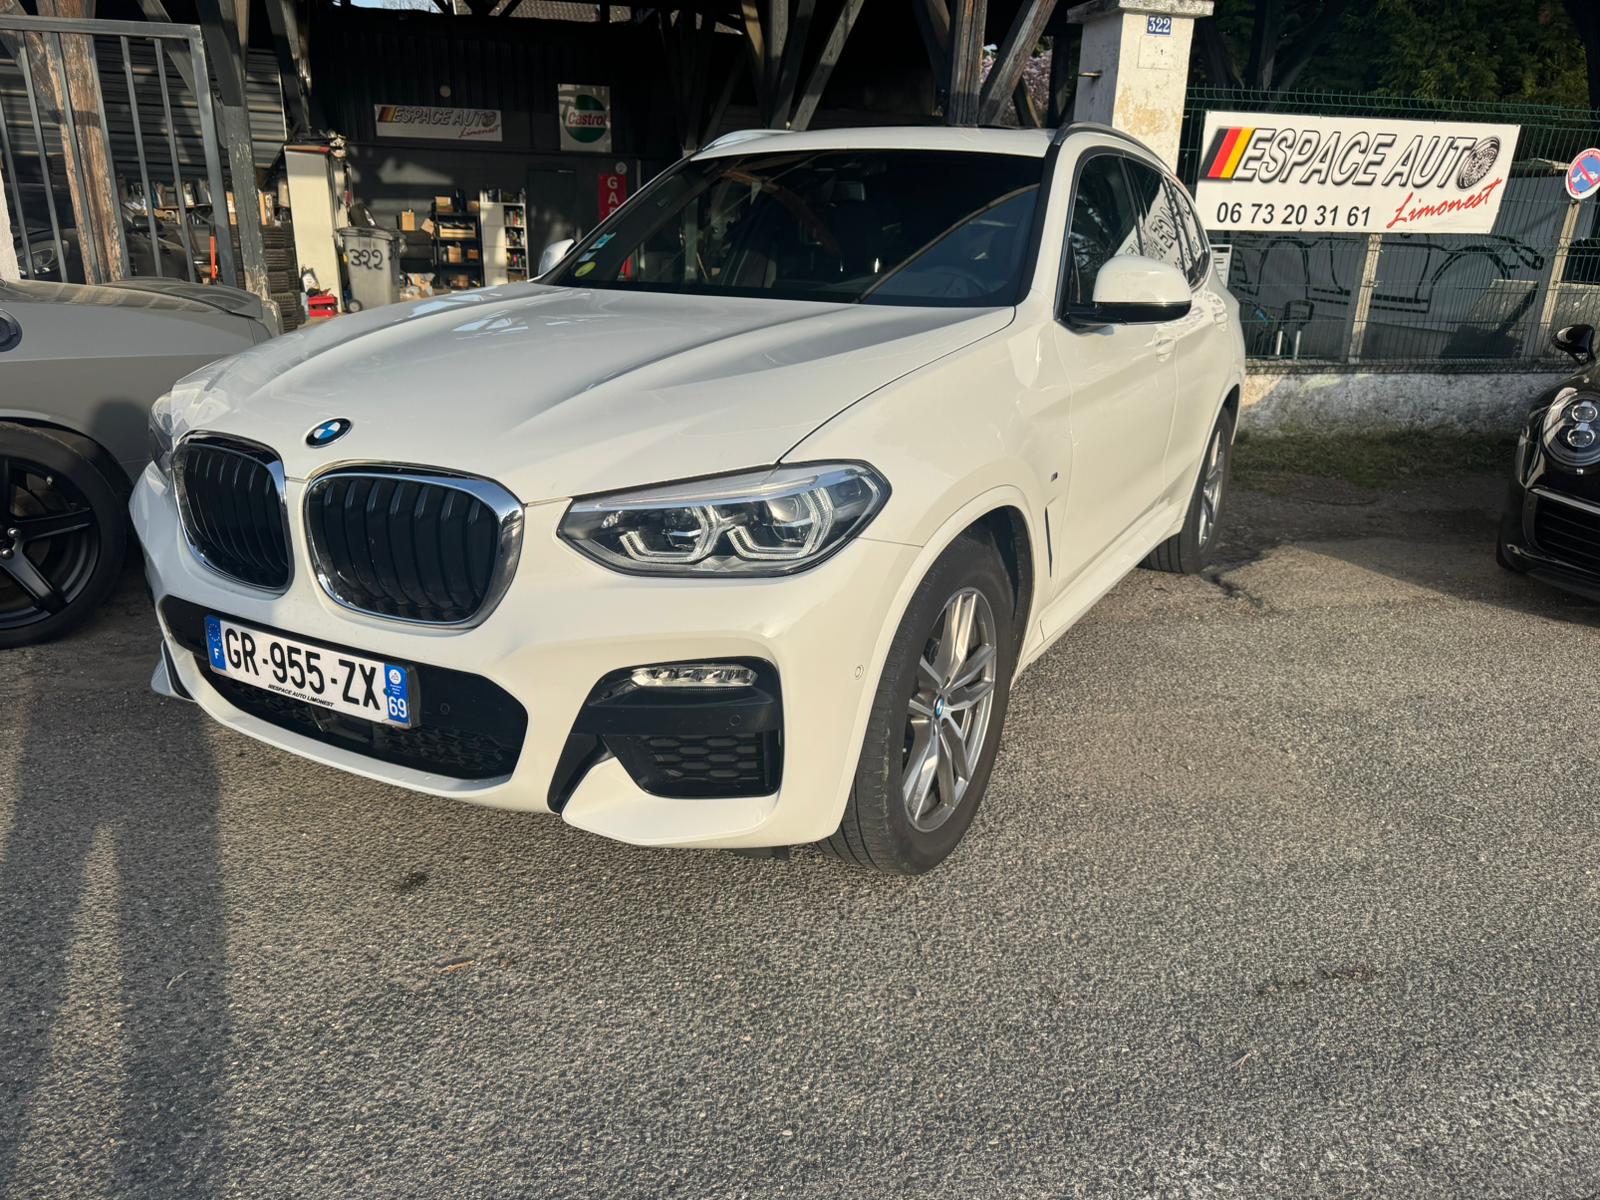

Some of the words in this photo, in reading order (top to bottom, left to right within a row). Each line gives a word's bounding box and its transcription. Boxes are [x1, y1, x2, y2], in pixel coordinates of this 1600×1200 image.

[1148, 17, 1170, 33] 322
[394, 106, 454, 126] ESPACE
[568, 111, 608, 126] Castrol
[1232, 127, 1397, 187] ESPACE
[1386, 177, 1502, 229] Limonest
[1216, 202, 1242, 225] 06
[1250, 203, 1275, 225] 73
[1281, 204, 1307, 226] 20
[1314, 205, 1339, 227] 31
[1346, 206, 1371, 227] 61
[349, 248, 383, 270] 322
[214, 648, 220, 660] F
[224, 627, 381, 711] GR-955-ZX
[292, 691, 307, 700] AUTO
[388, 696, 407, 719] 69
